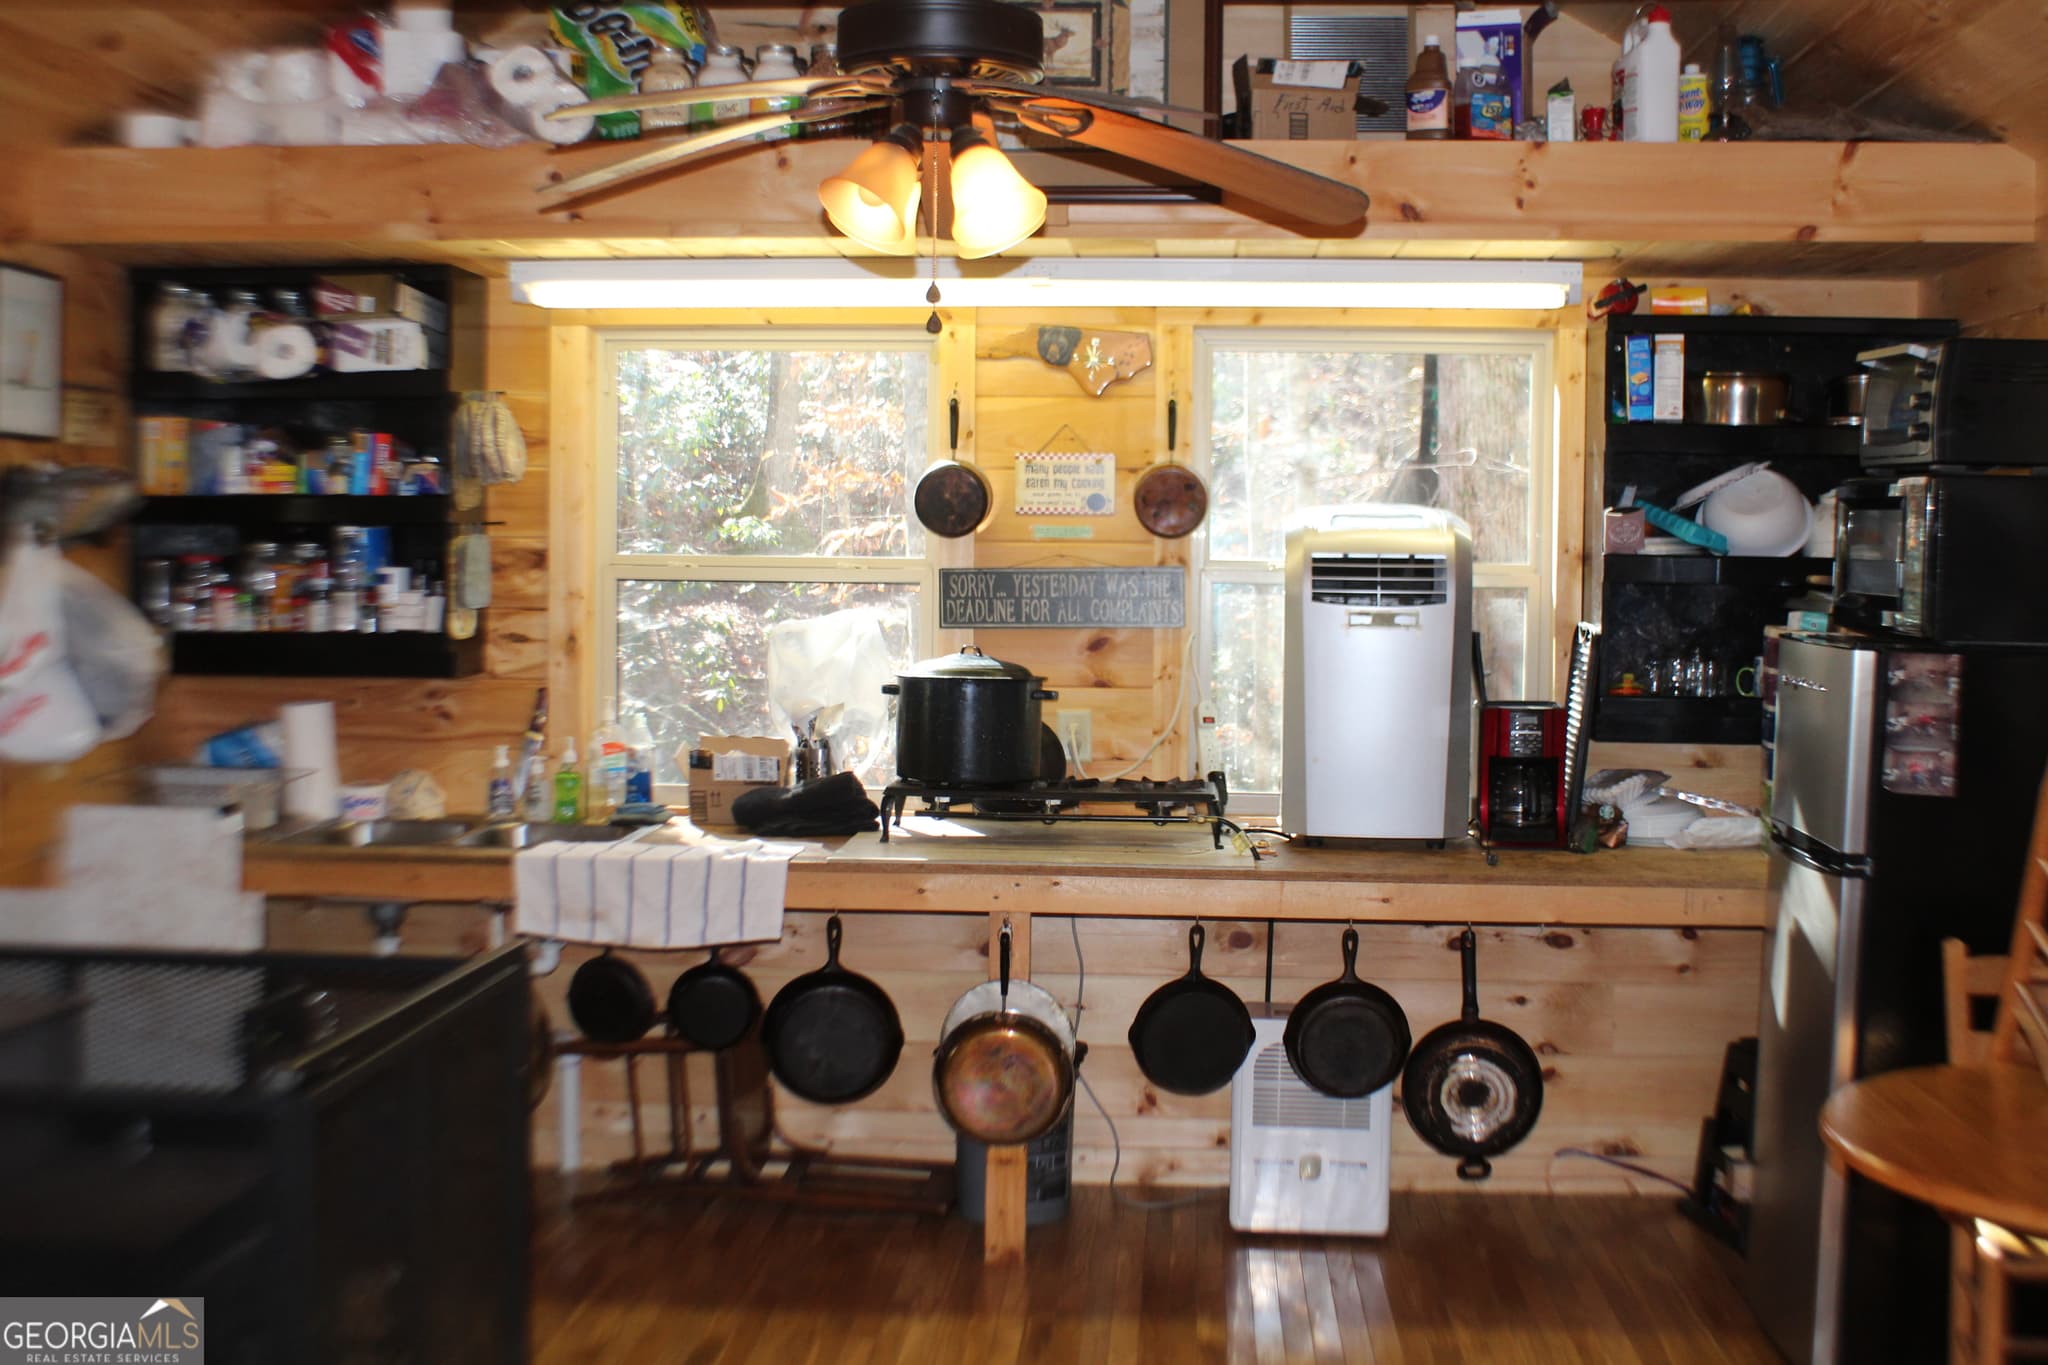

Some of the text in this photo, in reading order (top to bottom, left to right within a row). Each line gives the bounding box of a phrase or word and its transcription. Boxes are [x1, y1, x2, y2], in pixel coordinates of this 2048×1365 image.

[1274, 93, 1312, 112] First
[1013, 573, 1097, 598] YESTERDAY
[946, 599, 1180, 624] DEADLINE FOR ALL COMPLAINTS
